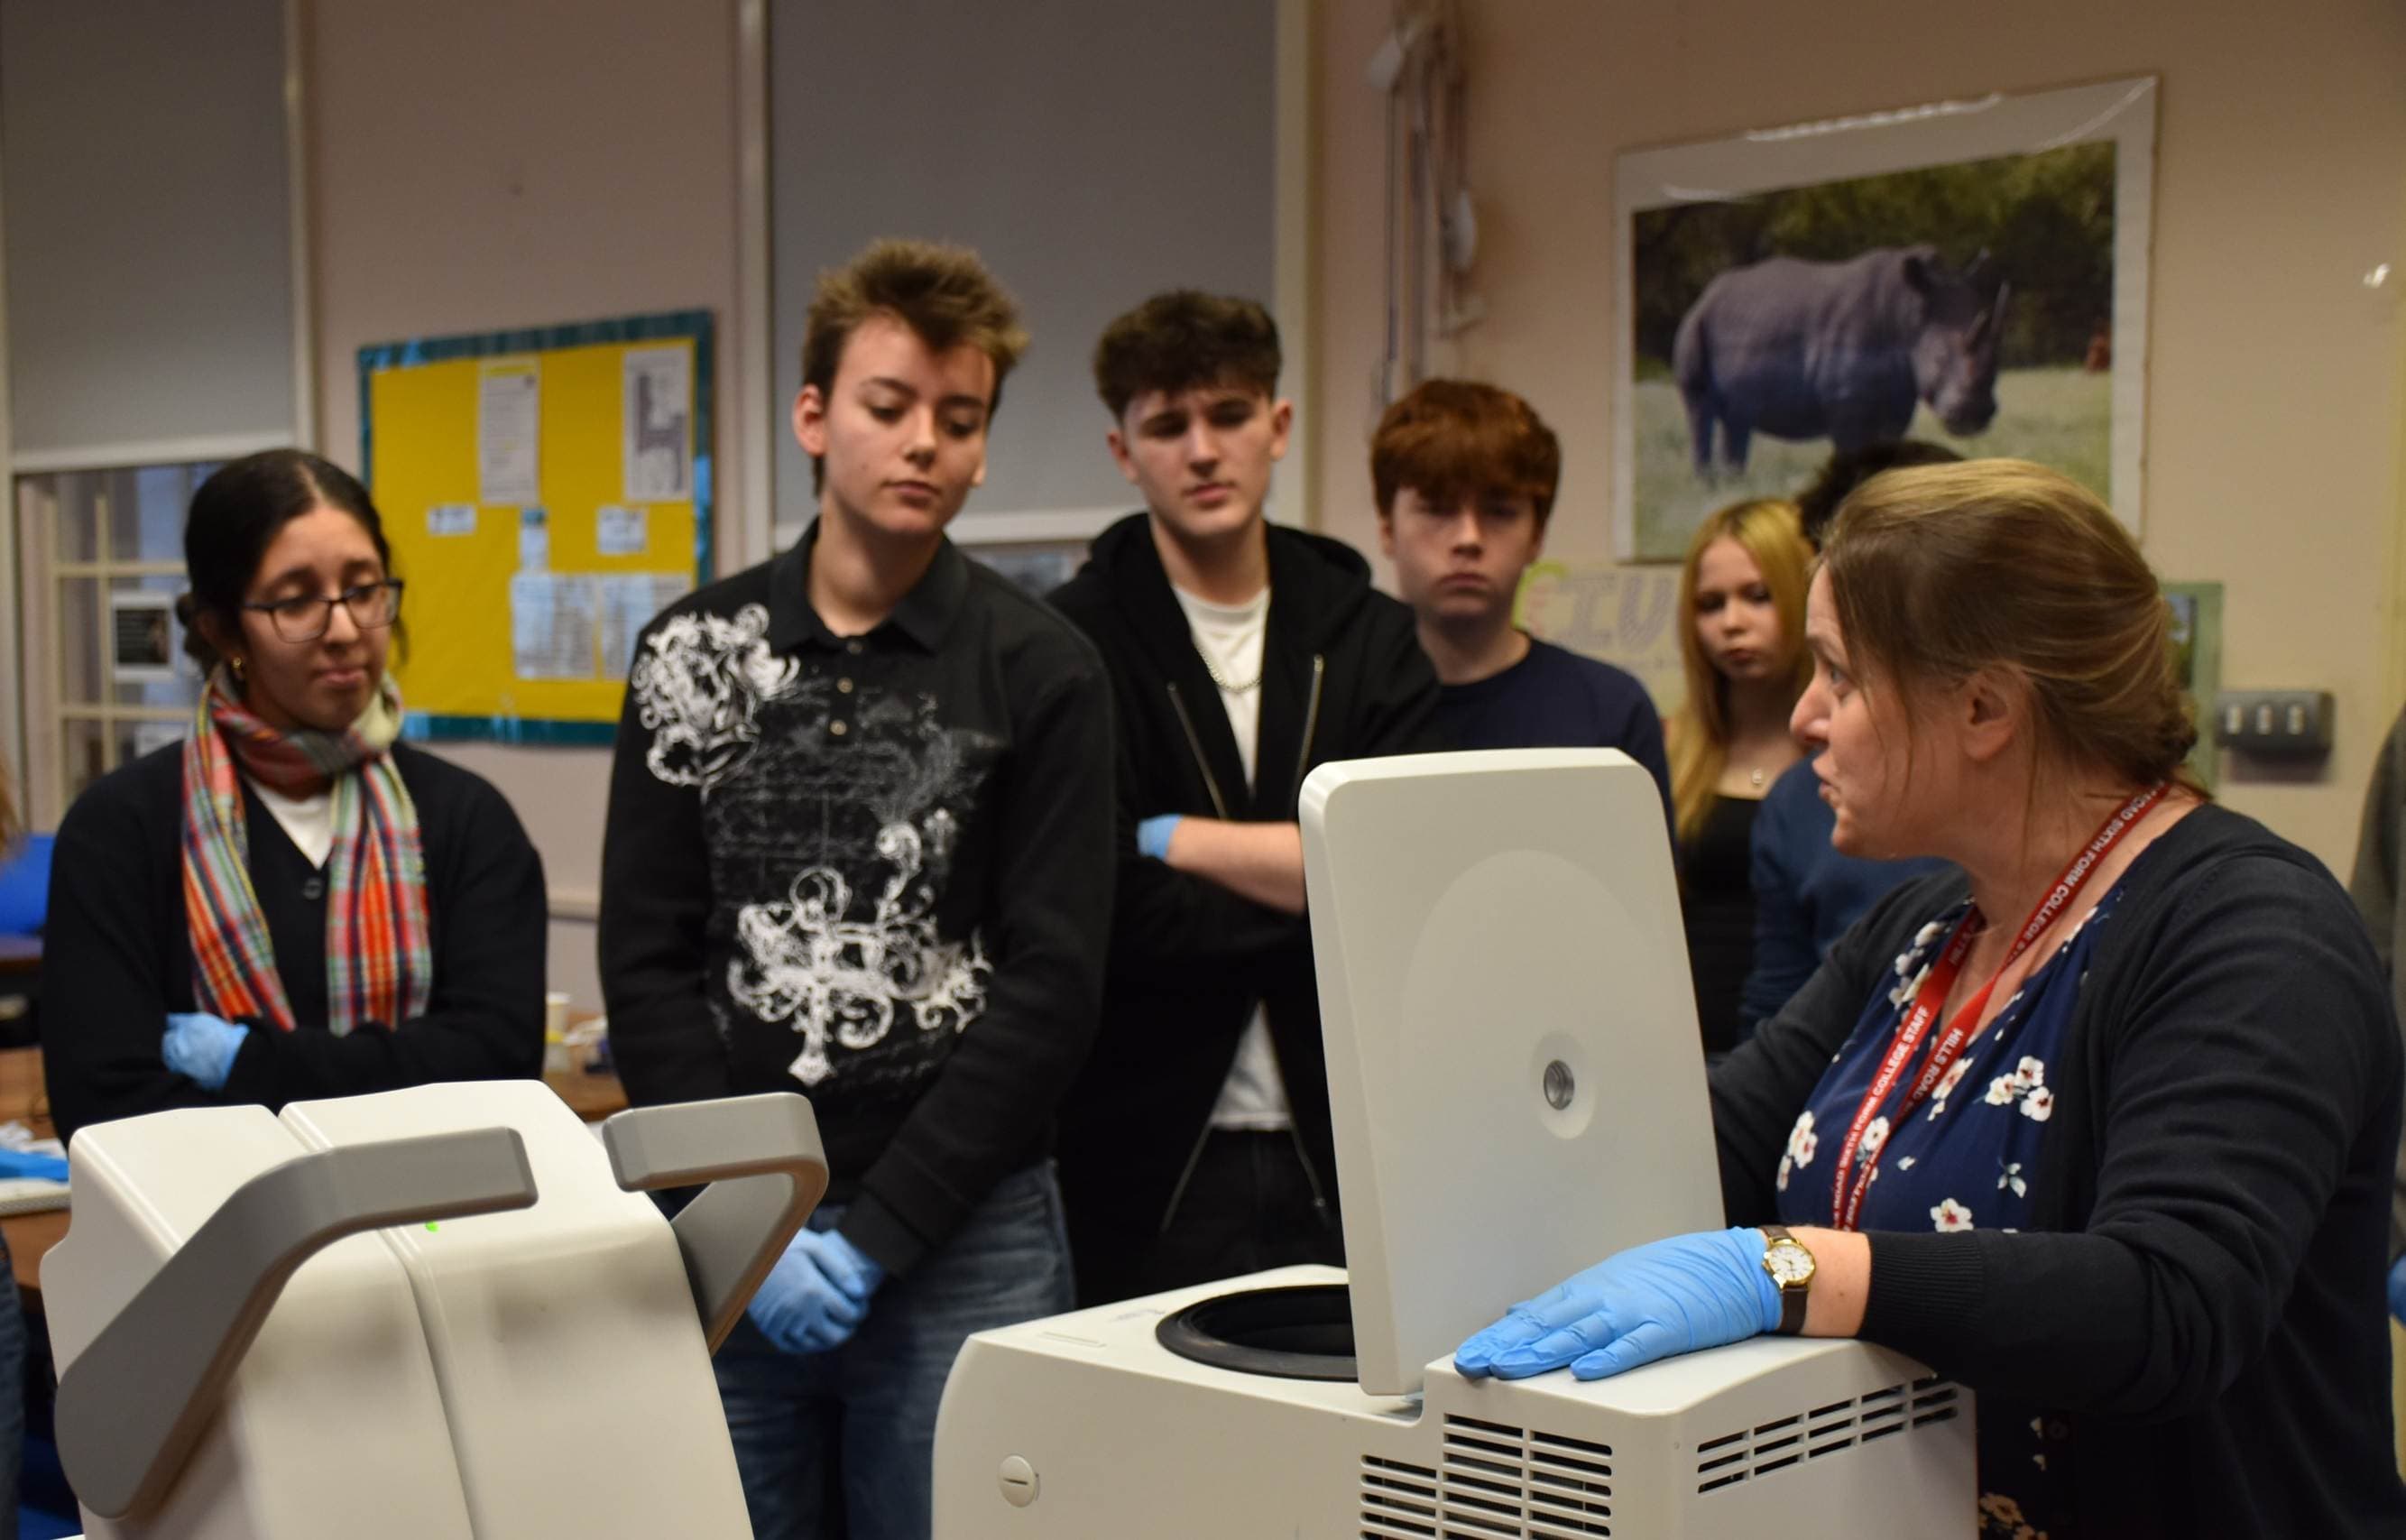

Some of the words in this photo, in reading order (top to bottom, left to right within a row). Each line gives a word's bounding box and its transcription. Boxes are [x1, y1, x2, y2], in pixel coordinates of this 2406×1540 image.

[2091, 817, 2124, 853] SIXTH
[2064, 850, 2097, 888] FORM
[2023, 884, 2070, 941] COLLEGE
[1933, 1028, 1964, 1065] HILLS
[1854, 1096, 1878, 1130] FORM
[1872, 1041, 1909, 1095] COLLEGE
[1902, 1005, 1929, 1042] STAFF
[1913, 1062, 1940, 1101] ROAD
